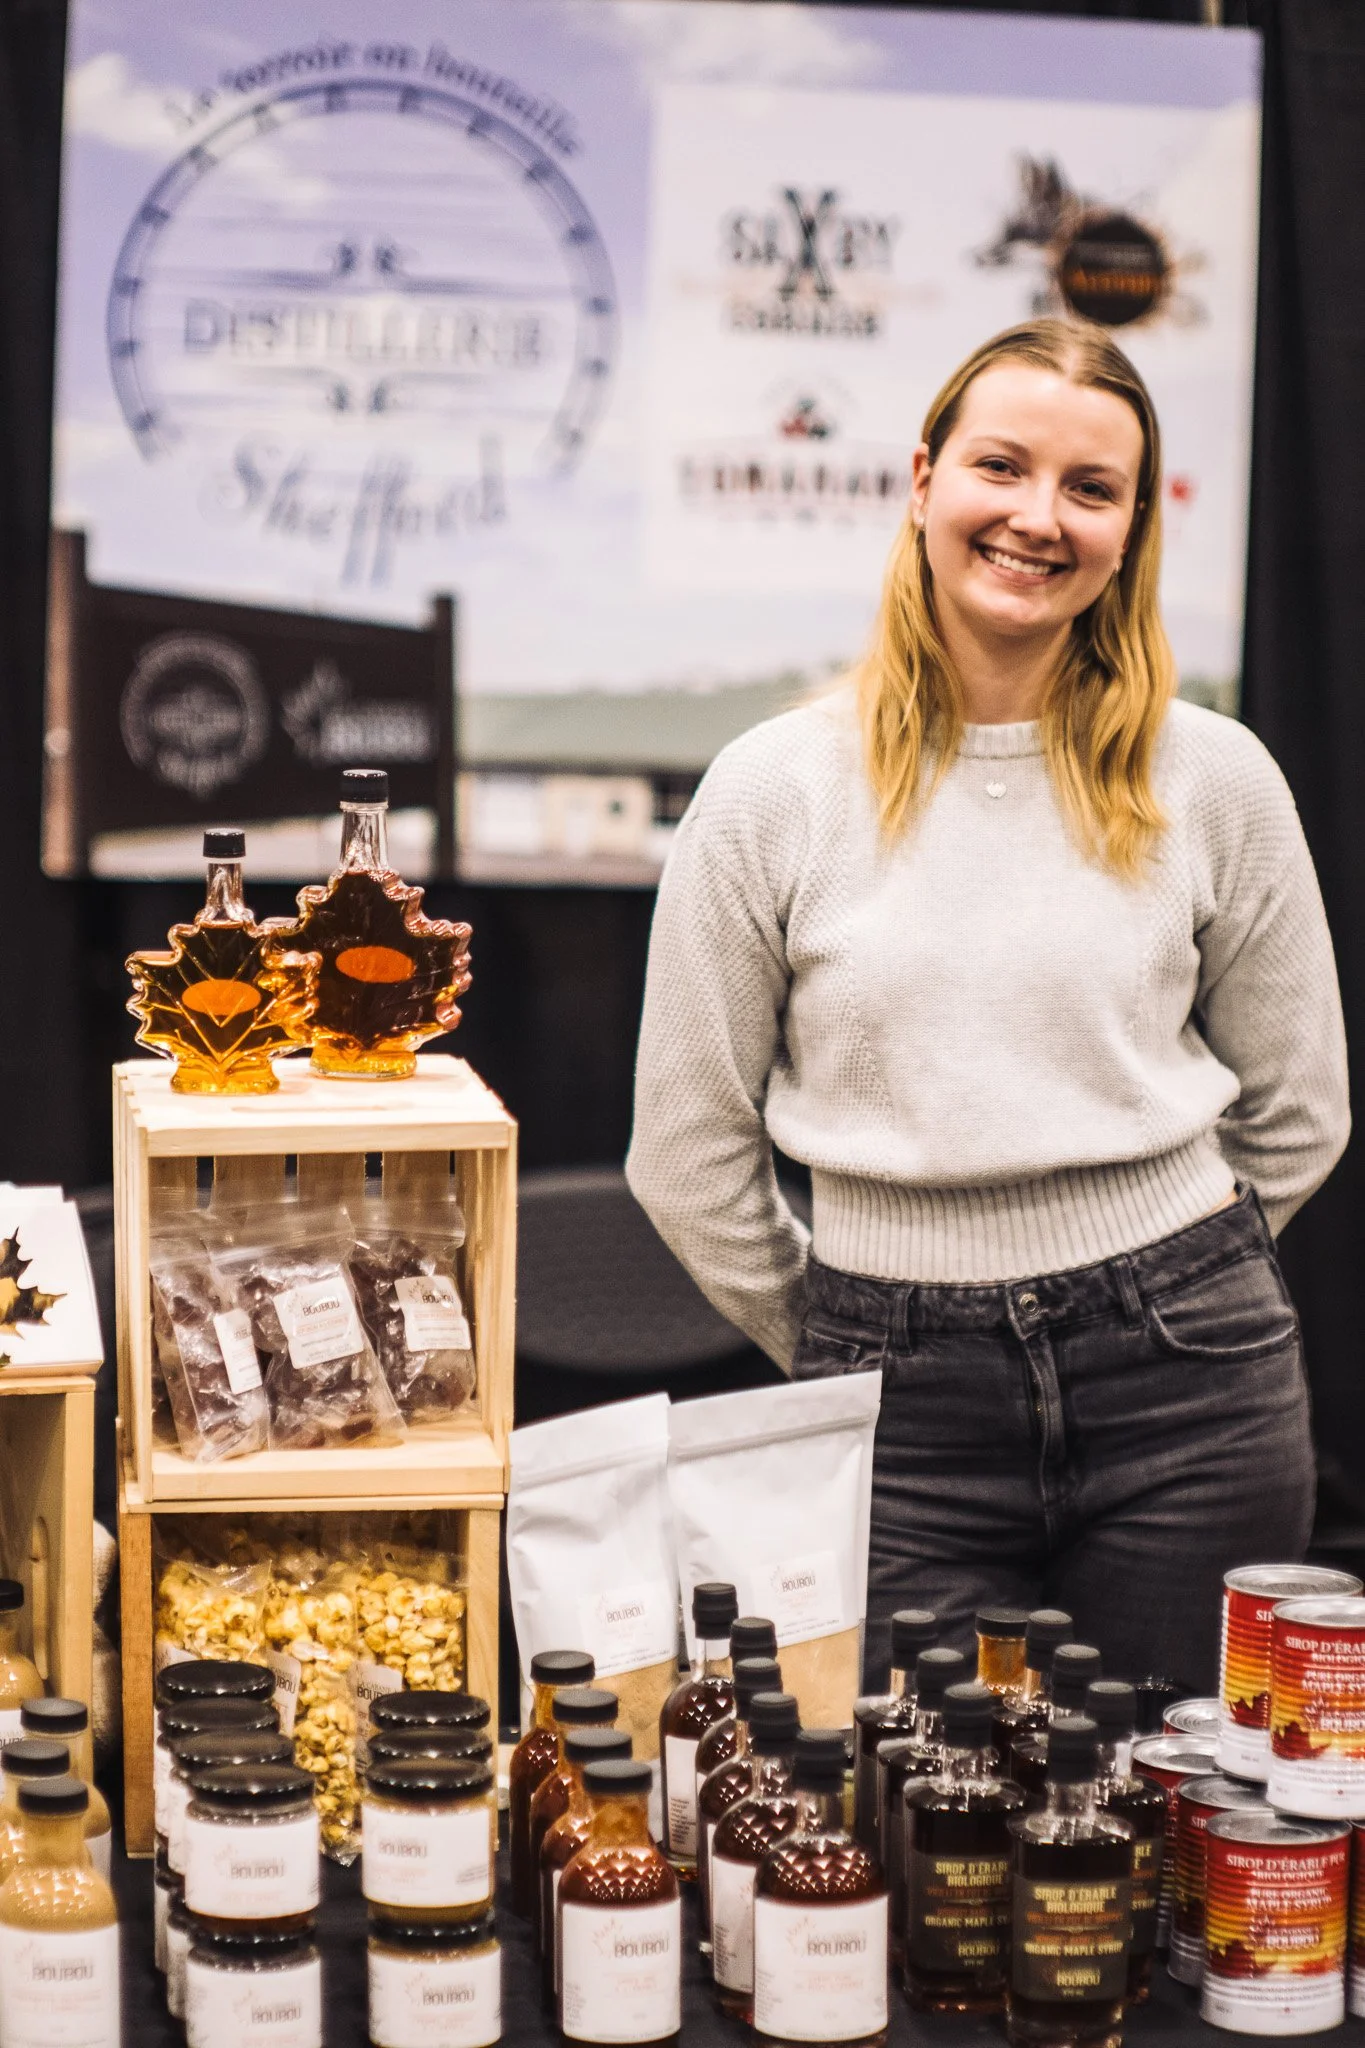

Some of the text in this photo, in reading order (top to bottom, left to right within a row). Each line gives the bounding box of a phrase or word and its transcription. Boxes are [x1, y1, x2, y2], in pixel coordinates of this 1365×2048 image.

[781, 1575, 816, 1592] BOUBOU
[606, 1604, 645, 1623] BOUBOU
[1285, 1635, 1318, 1652] SIROP
[935, 1861, 965, 1876] SIROP
[1226, 1854, 1263, 1869] SIROP
[1034, 1886, 1066, 1901] SIROP
[614, 1939, 669, 1958] BOUBOU
[807, 1939, 867, 1957] BOUBOU
[1063, 1944, 1096, 1956] MAPLE
